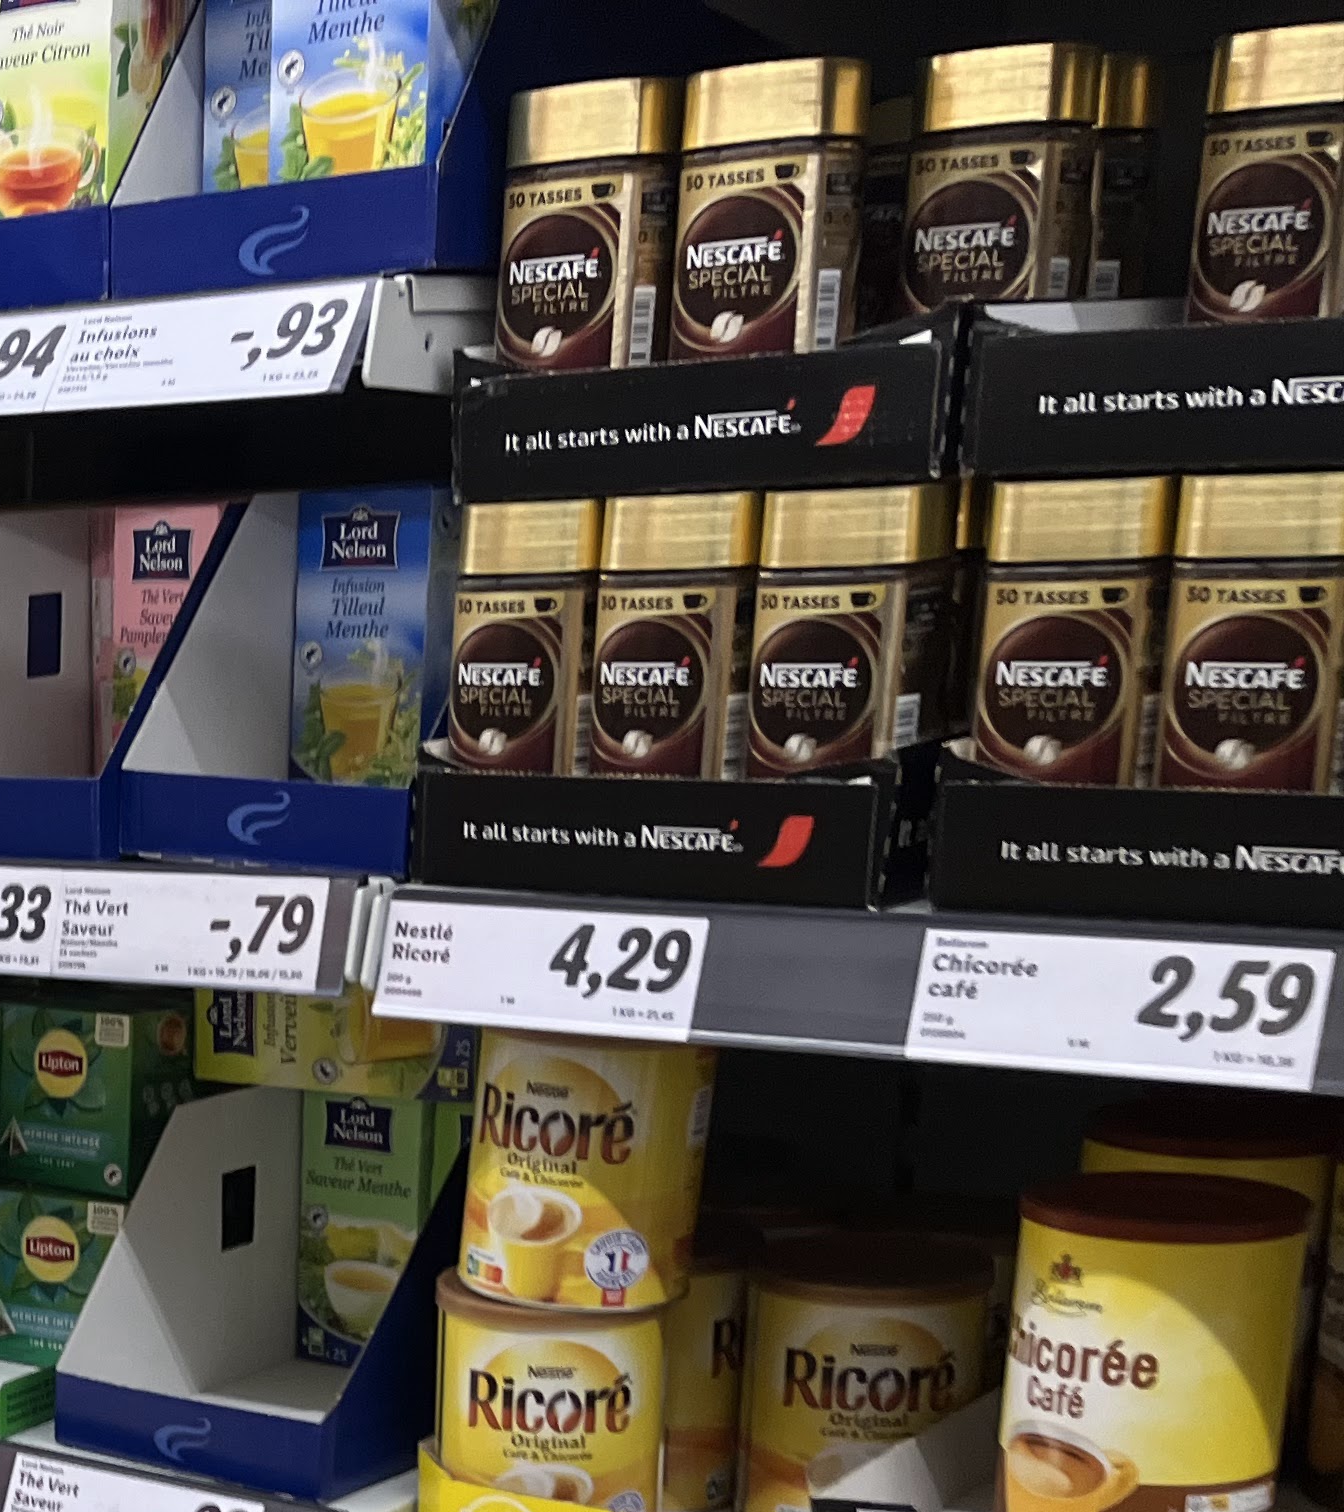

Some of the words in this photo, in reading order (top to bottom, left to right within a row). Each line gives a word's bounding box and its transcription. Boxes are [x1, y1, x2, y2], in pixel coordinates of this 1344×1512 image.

[307, 11, 386, 45] Menthe
[41, 40, 92, 64] Citron
[688, 263, 773, 293] SPECIAL
[77, 323, 159, 344] Infusions
[230, 298, 349, 370] -,93
[69, 348, 96, 364] au
[99, 343, 141, 364] choix
[338, 522, 378, 544] Lord
[331, 539, 386, 560] Nelson
[331, 597, 384, 618] Tilleul
[997, 589, 1018, 605] 50
[1023, 590, 1089, 605] TASSES
[1187, 587, 1210, 603] 50
[1217, 588, 1286, 604] TASSES
[325, 620, 390, 640] Menthe
[463, 821, 478, 839] It
[482, 823, 508, 841] all
[512, 825, 570, 846] starts
[575, 827, 619, 847] with
[624, 833, 636, 848] a
[64, 900, 91, 917] Thé
[94, 899, 129, 918] Vert
[61, 920, 114, 939] Saveur
[210, 895, 314, 963] -,79
[394, 921, 454, 942] Nestlé
[392, 942, 451, 966] Ricoré
[548, 923, 692, 999] 4,29
[932, 952, 1039, 980] Chicorée
[928, 977, 978, 1001] café
[1136, 955, 1317, 1041] 2,59
[339, 1108, 376, 1128] Lord
[479, 1081, 636, 1166] Ricoré
[61, 1132, 100, 1148] INTENSE
[332, 1123, 384, 1144] Nelson
[507, 1151, 578, 1175] Original
[305, 1172, 354, 1191] Saveur
[360, 1179, 412, 1200] Menthe
[783, 1346, 958, 1413] Ricoré
[468, 1368, 632, 1436] Ricoré
[1026, 1377, 1084, 1419] Café
[829, 1412, 909, 1430] Original
[19, 1468, 46, 1488] Thé
[48, 1474, 80, 1500] Vert
